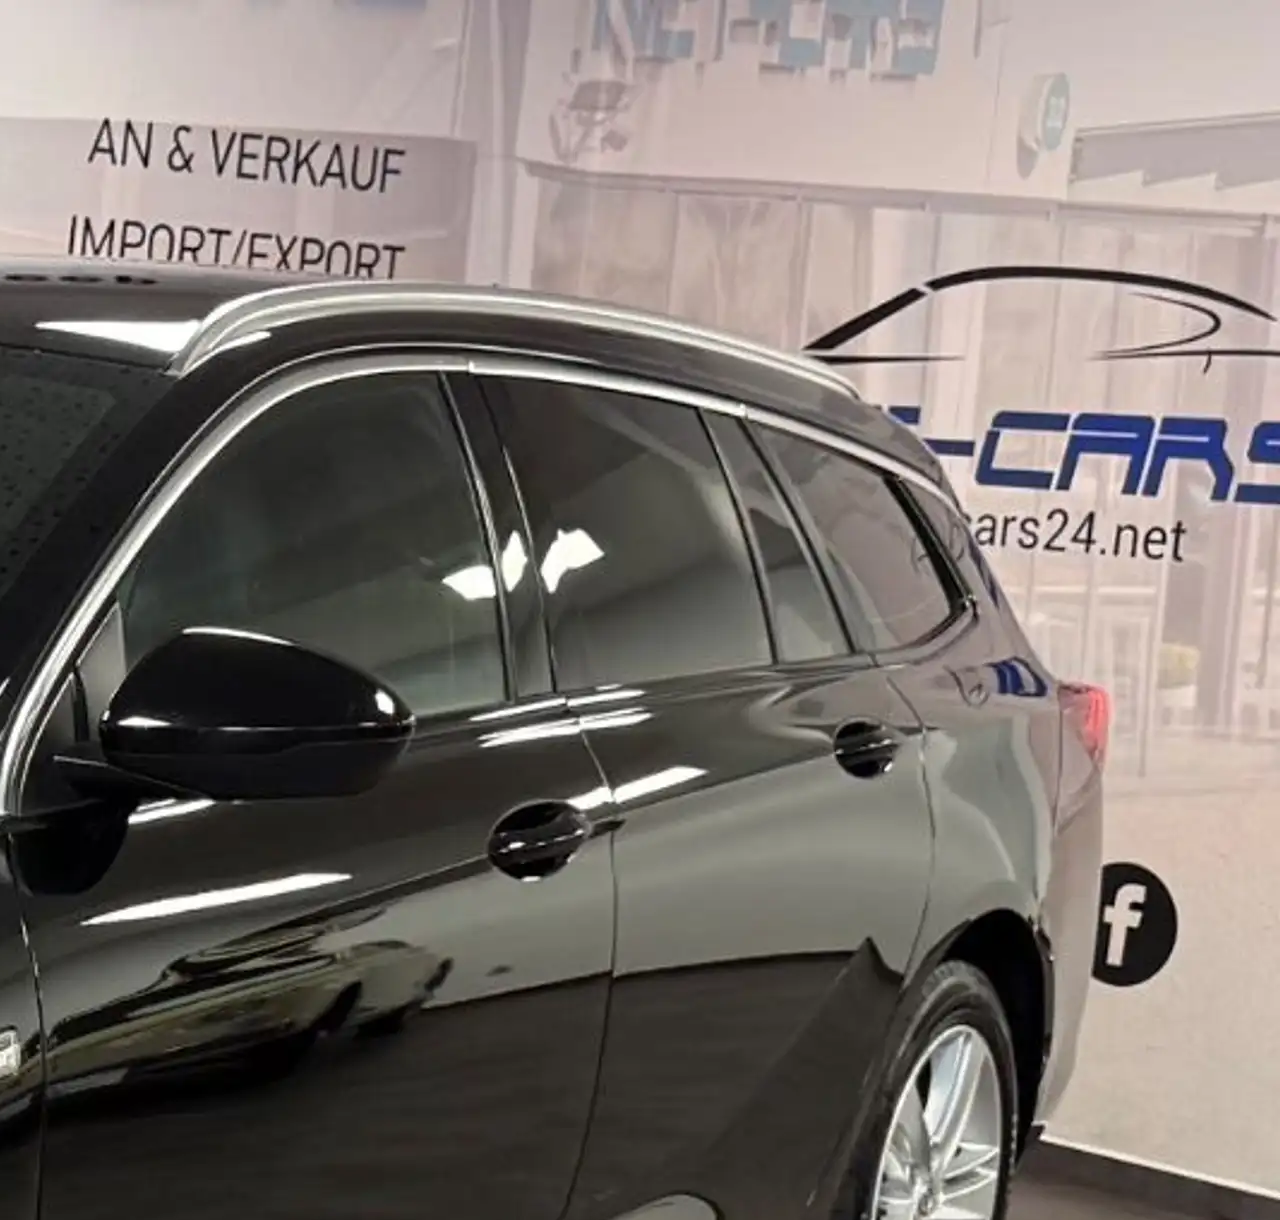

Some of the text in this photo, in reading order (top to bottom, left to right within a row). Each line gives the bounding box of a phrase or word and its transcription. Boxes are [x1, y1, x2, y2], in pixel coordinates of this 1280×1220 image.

[88, 117, 407, 193] AN & VERKAUF
[67, 214, 407, 280] IMPORT/EXPORT
[964, 508, 1188, 563] ars24.net
